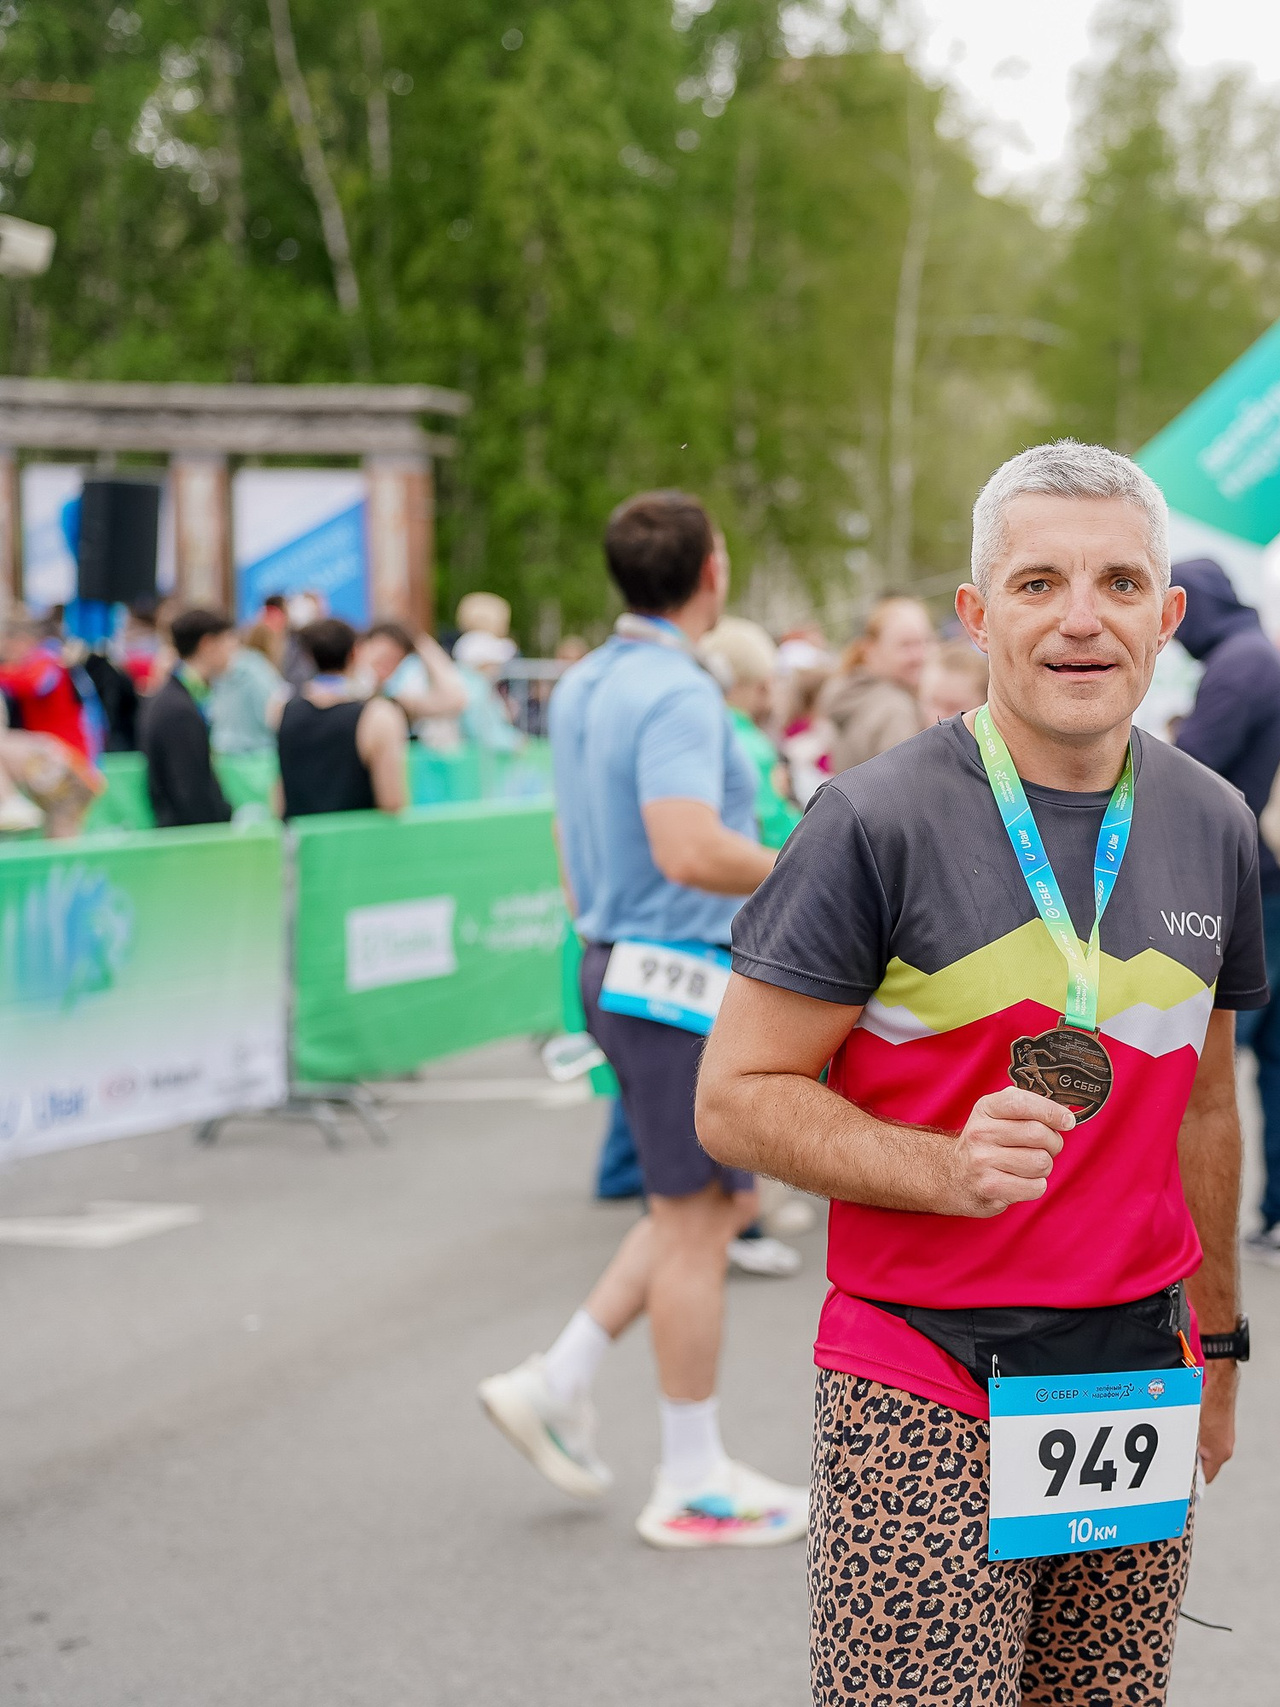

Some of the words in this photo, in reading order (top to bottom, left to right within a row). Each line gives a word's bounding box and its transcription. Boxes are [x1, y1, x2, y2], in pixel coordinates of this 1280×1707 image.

[985, 738, 997, 757] 185
[1018, 829, 1032, 849] Utair
[1107, 833, 1120, 850] Utair
[1035, 881, 1053, 906] СБЕР
[1073, 1079, 1102, 1094] СБЕР
[1051, 1389, 1079, 1400] СБЕР
[1038, 1423, 1159, 1498] 949
